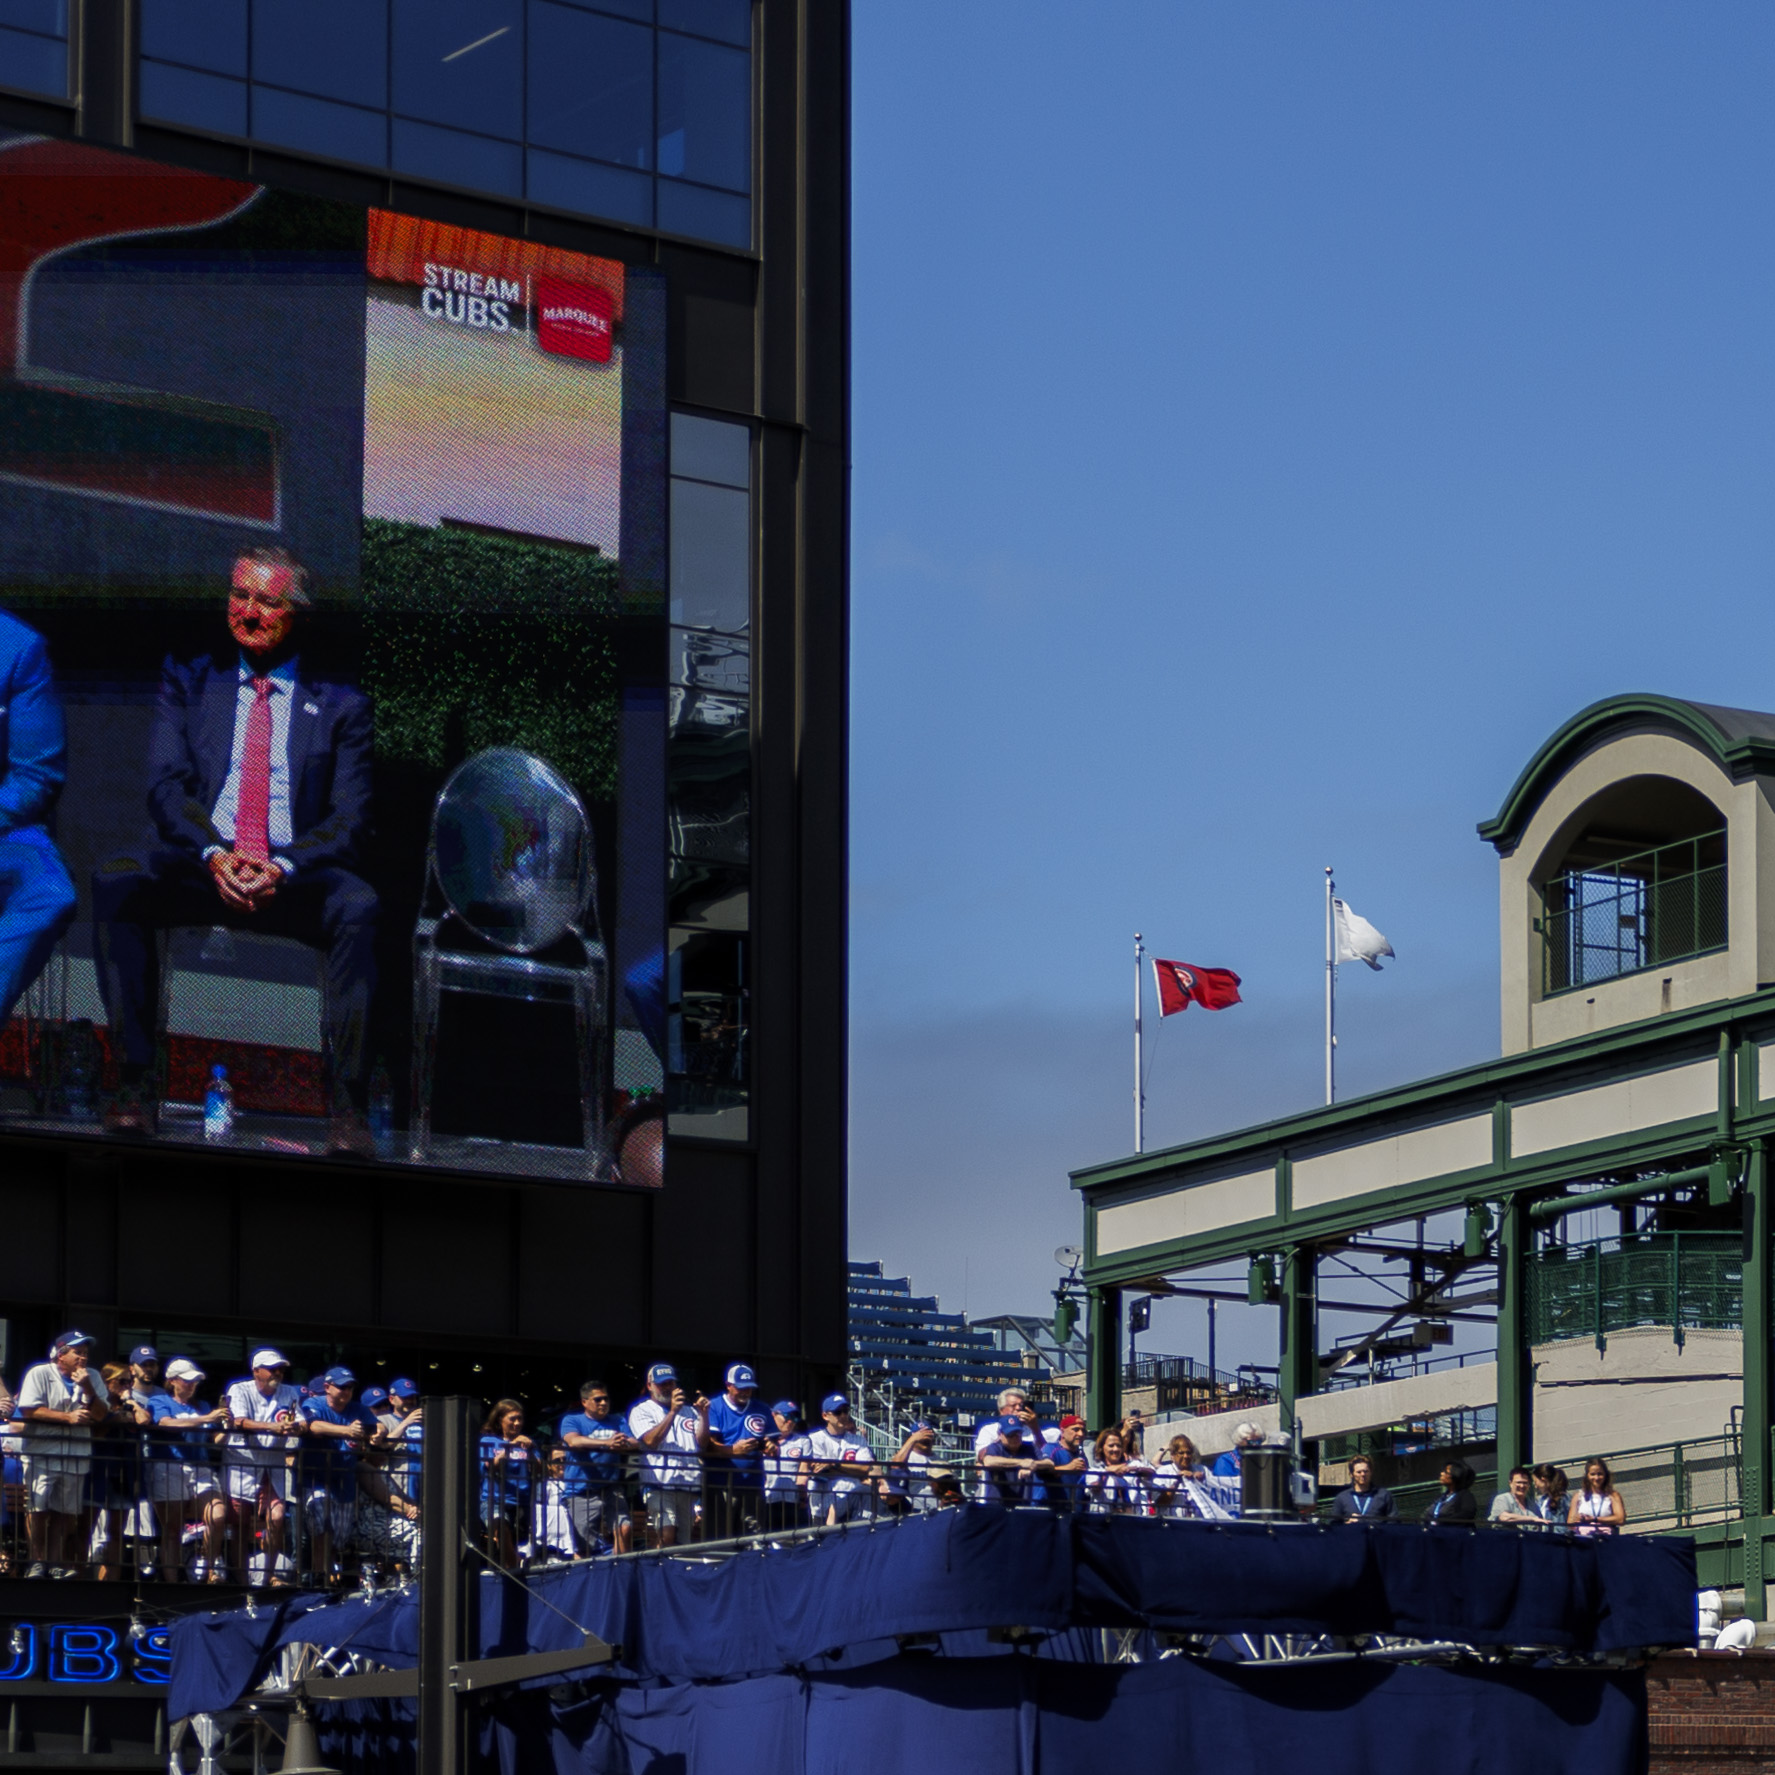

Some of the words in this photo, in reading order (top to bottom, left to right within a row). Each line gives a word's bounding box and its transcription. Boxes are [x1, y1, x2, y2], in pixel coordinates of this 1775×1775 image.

[424, 263, 520, 303] STREAM
[422, 286, 510, 334] CUBS
[542, 306, 608, 333] MARQUEE
